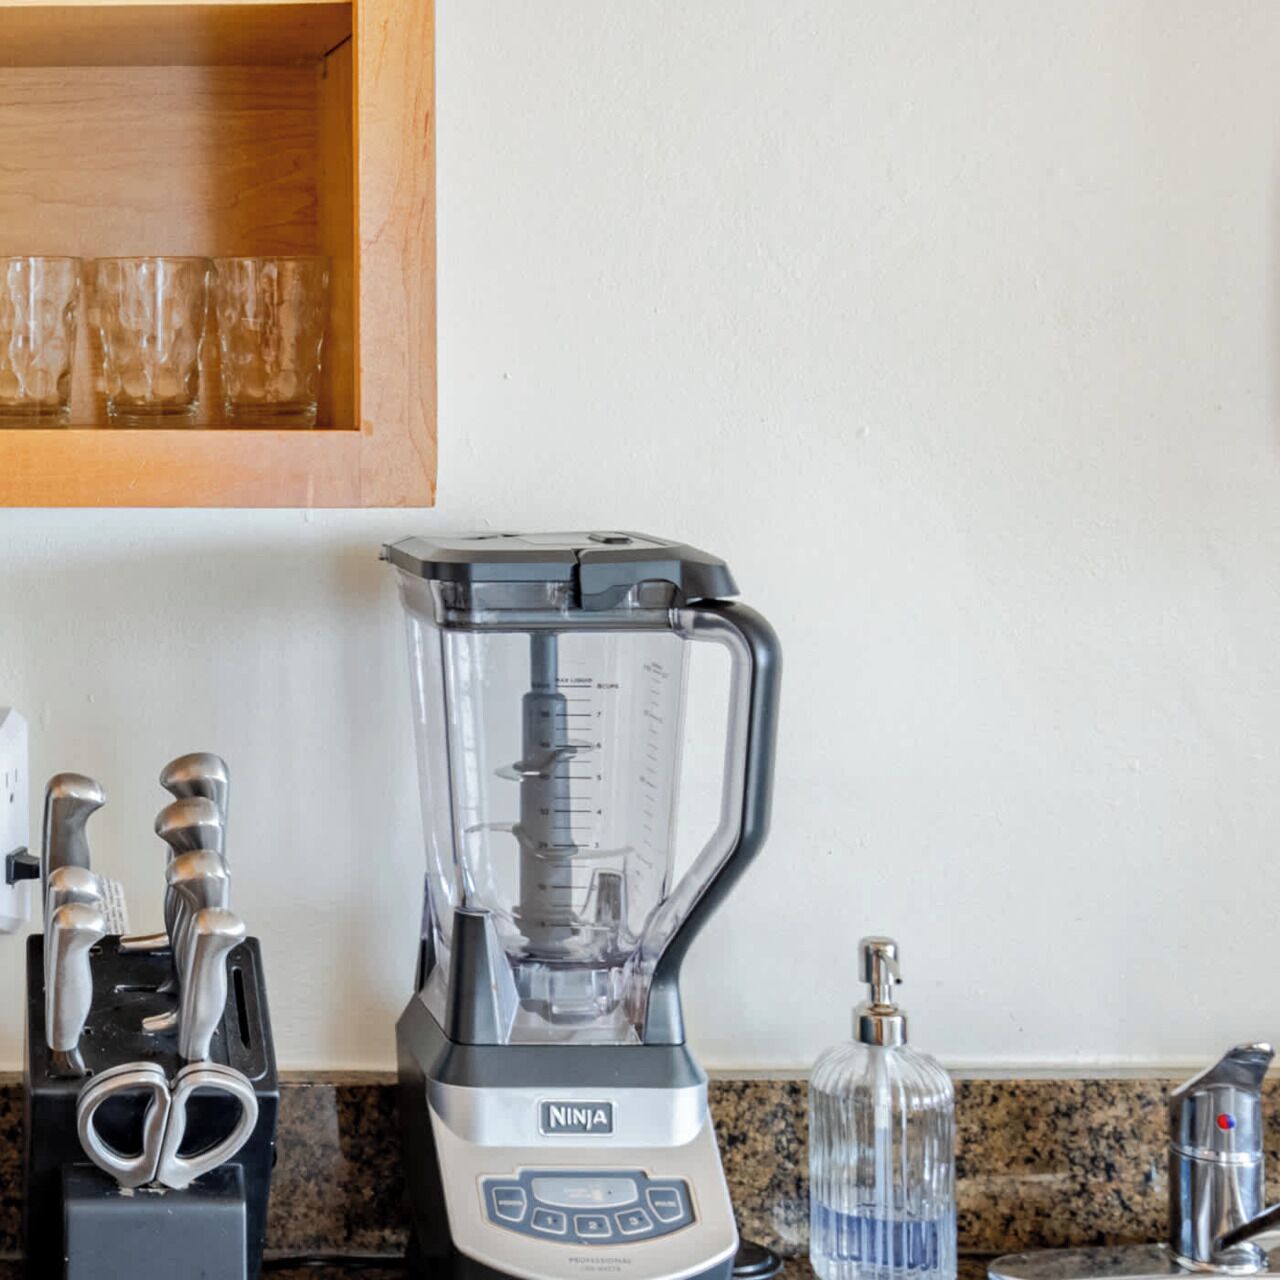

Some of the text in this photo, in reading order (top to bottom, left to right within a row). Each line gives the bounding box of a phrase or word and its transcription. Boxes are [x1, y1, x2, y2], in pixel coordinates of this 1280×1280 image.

[550, 1104, 608, 1131] NINJA
[588, 1220, 597, 1230] 2
[628, 1216, 639, 1226] 3
